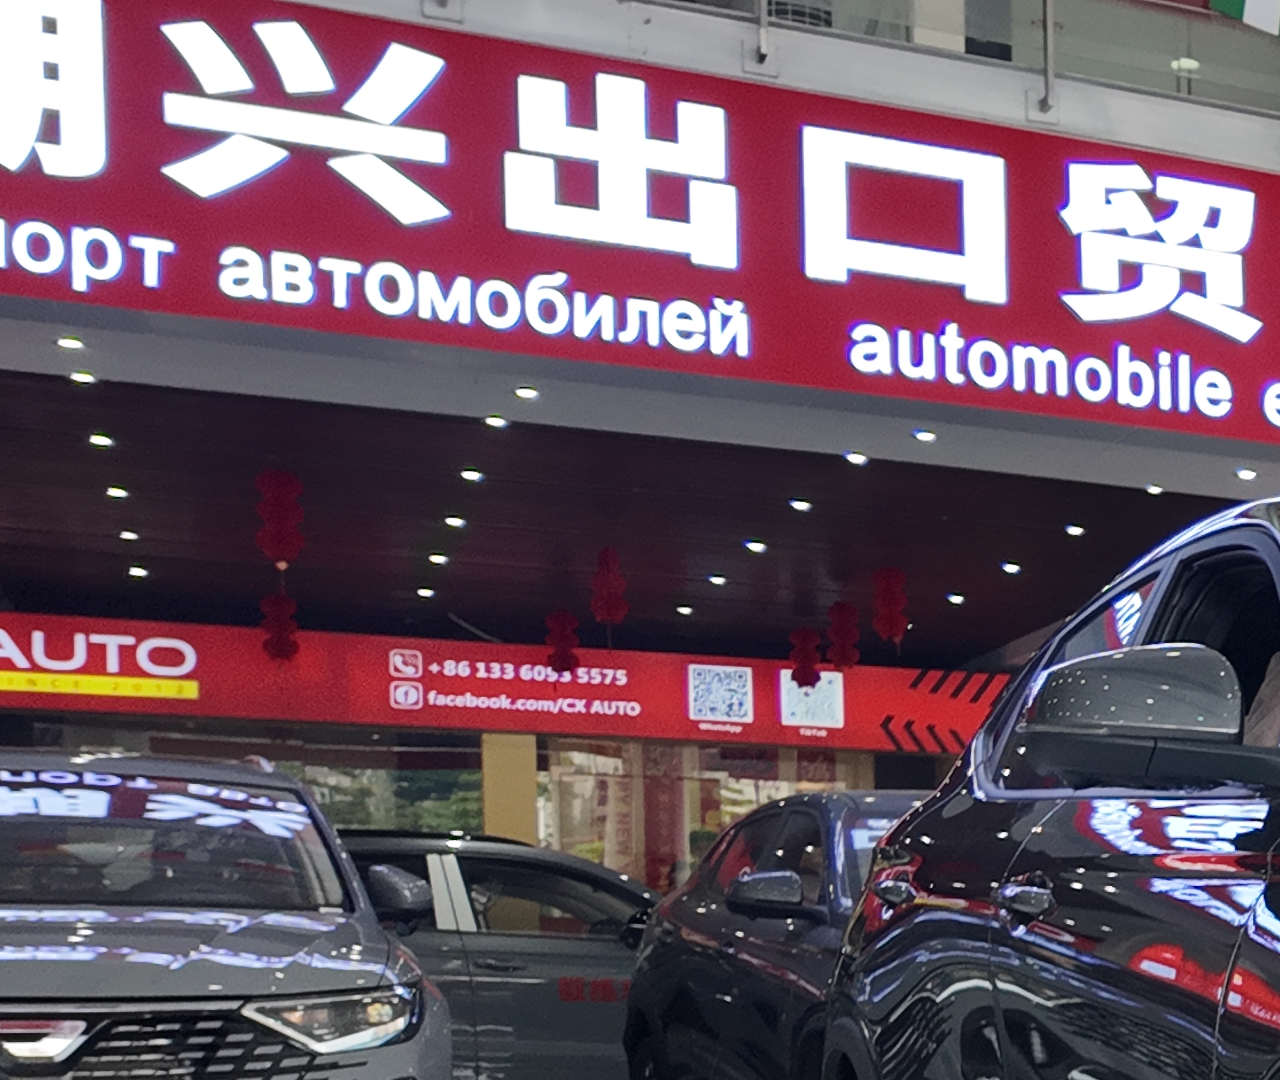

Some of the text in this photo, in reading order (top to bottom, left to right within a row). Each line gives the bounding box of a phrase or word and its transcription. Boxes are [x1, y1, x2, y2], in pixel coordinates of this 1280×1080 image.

[217, 244, 749, 358] автомобилей
[848, 320, 1233, 419] automobile
[427, 690, 642, 717] facebook.com/CX AUTO
[428, 660, 471, 678] +86
[475, 662, 515, 680] 133
[576, 667, 629, 686] 5575
